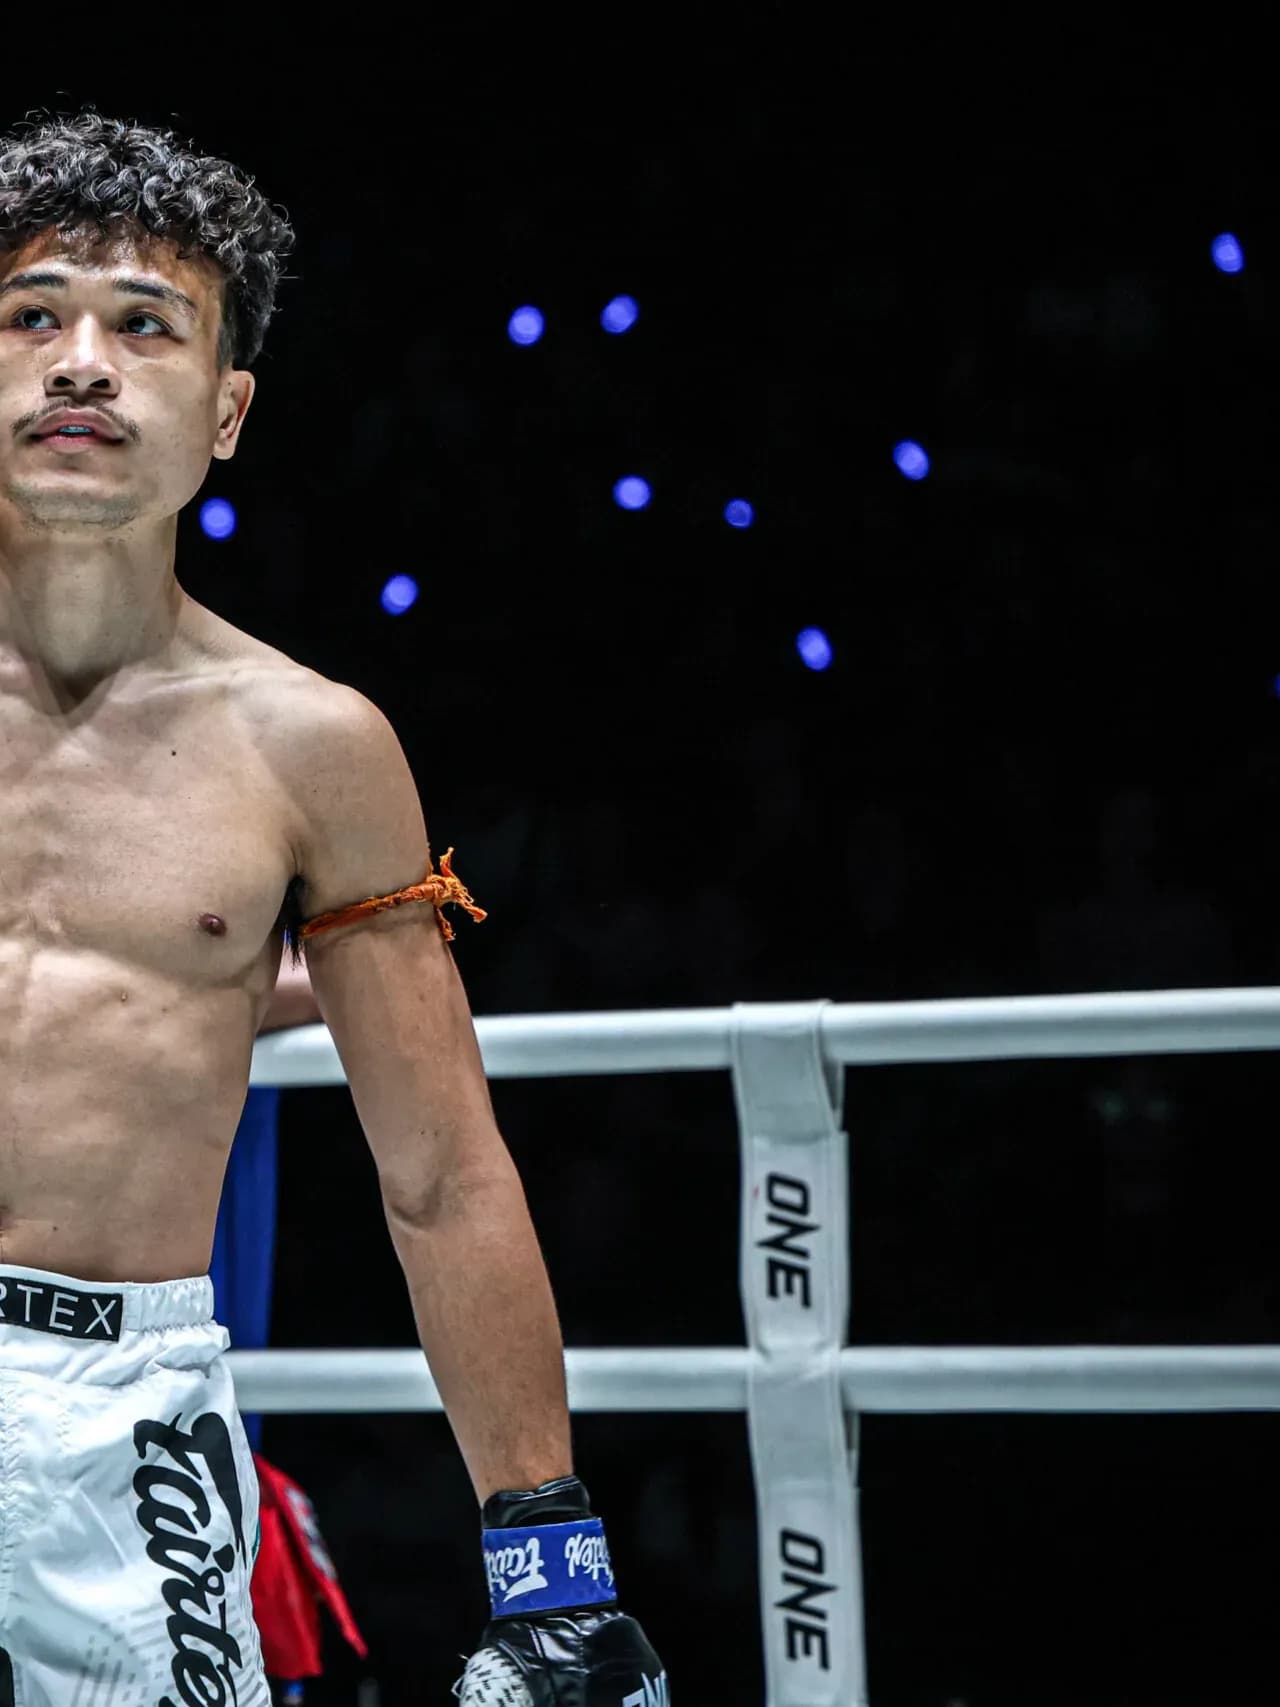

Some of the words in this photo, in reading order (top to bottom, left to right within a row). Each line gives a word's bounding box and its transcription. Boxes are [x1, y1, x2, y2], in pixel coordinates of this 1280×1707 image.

[755, 1172, 821, 1309] ONE
[132, 1411, 247, 1707] Fairte
[773, 1529, 839, 1672] ONE
